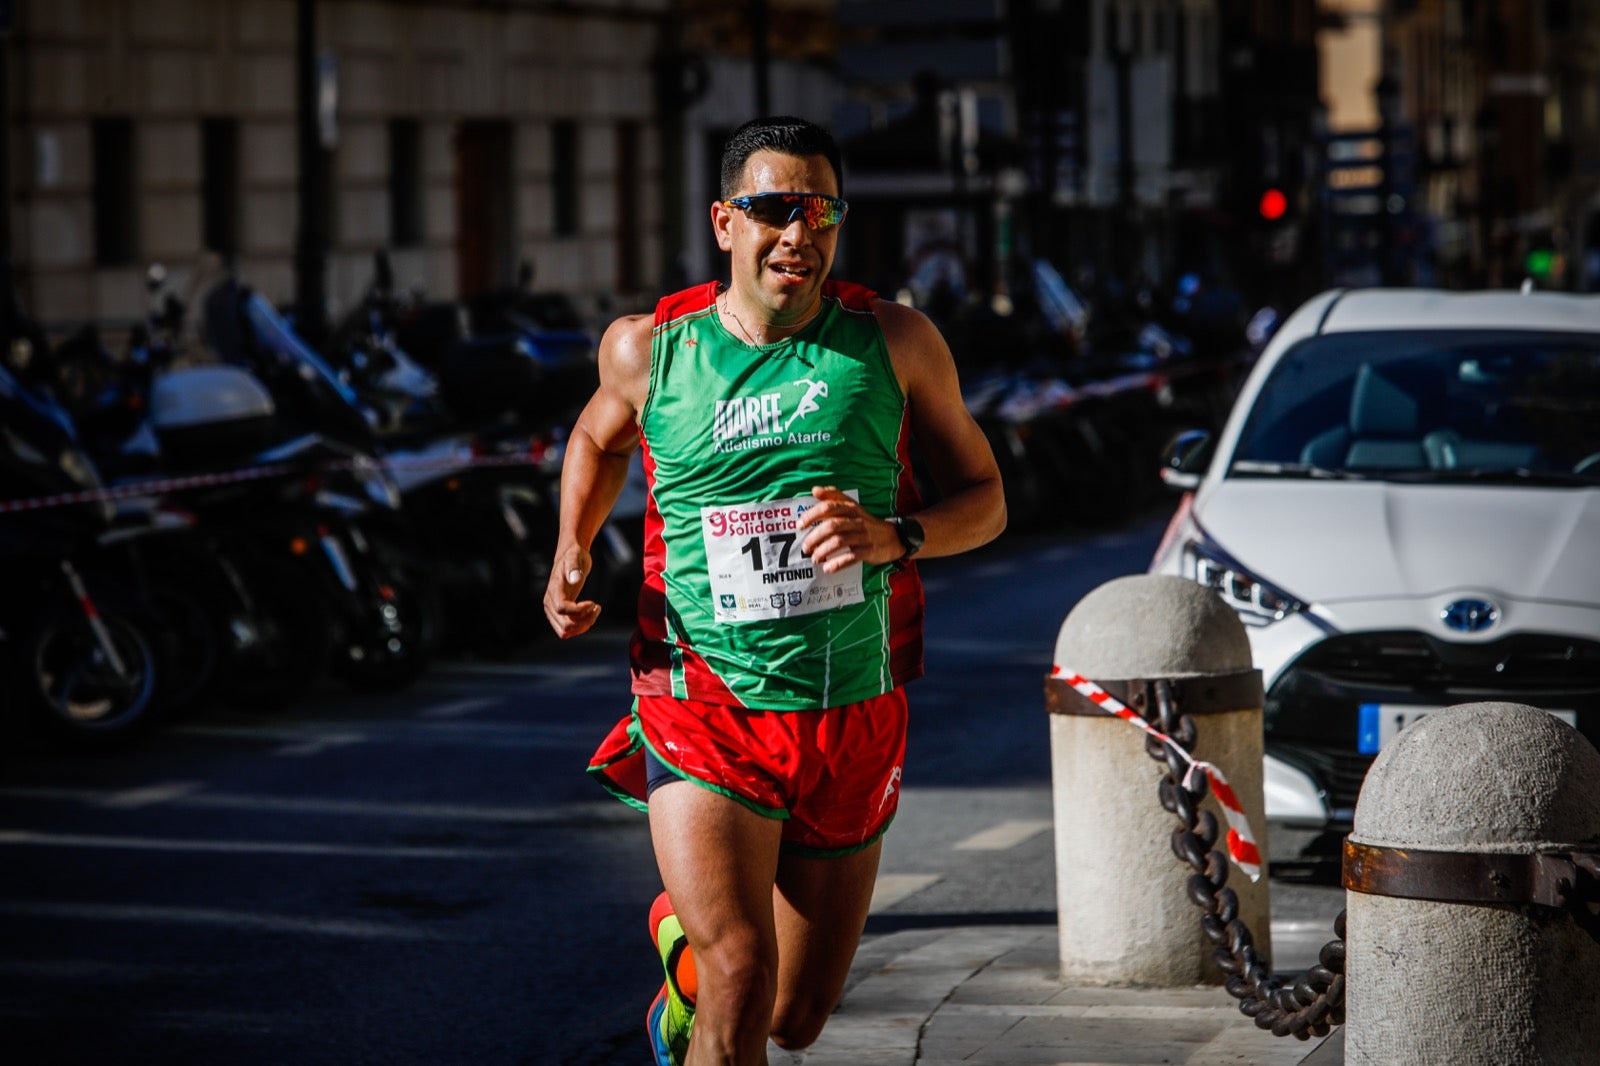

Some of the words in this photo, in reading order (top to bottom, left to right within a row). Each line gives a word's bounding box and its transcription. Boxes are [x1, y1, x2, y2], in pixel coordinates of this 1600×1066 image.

[713, 392, 783, 441] ATARFE
[714, 435, 783, 453] Atletismo
[787, 430, 831, 444] Atarfe
[728, 506, 792, 523] Carrera
[729, 518, 797, 537] Solidaria
[741, 533, 815, 571] 17
[762, 567, 814, 585] ANTONIO
